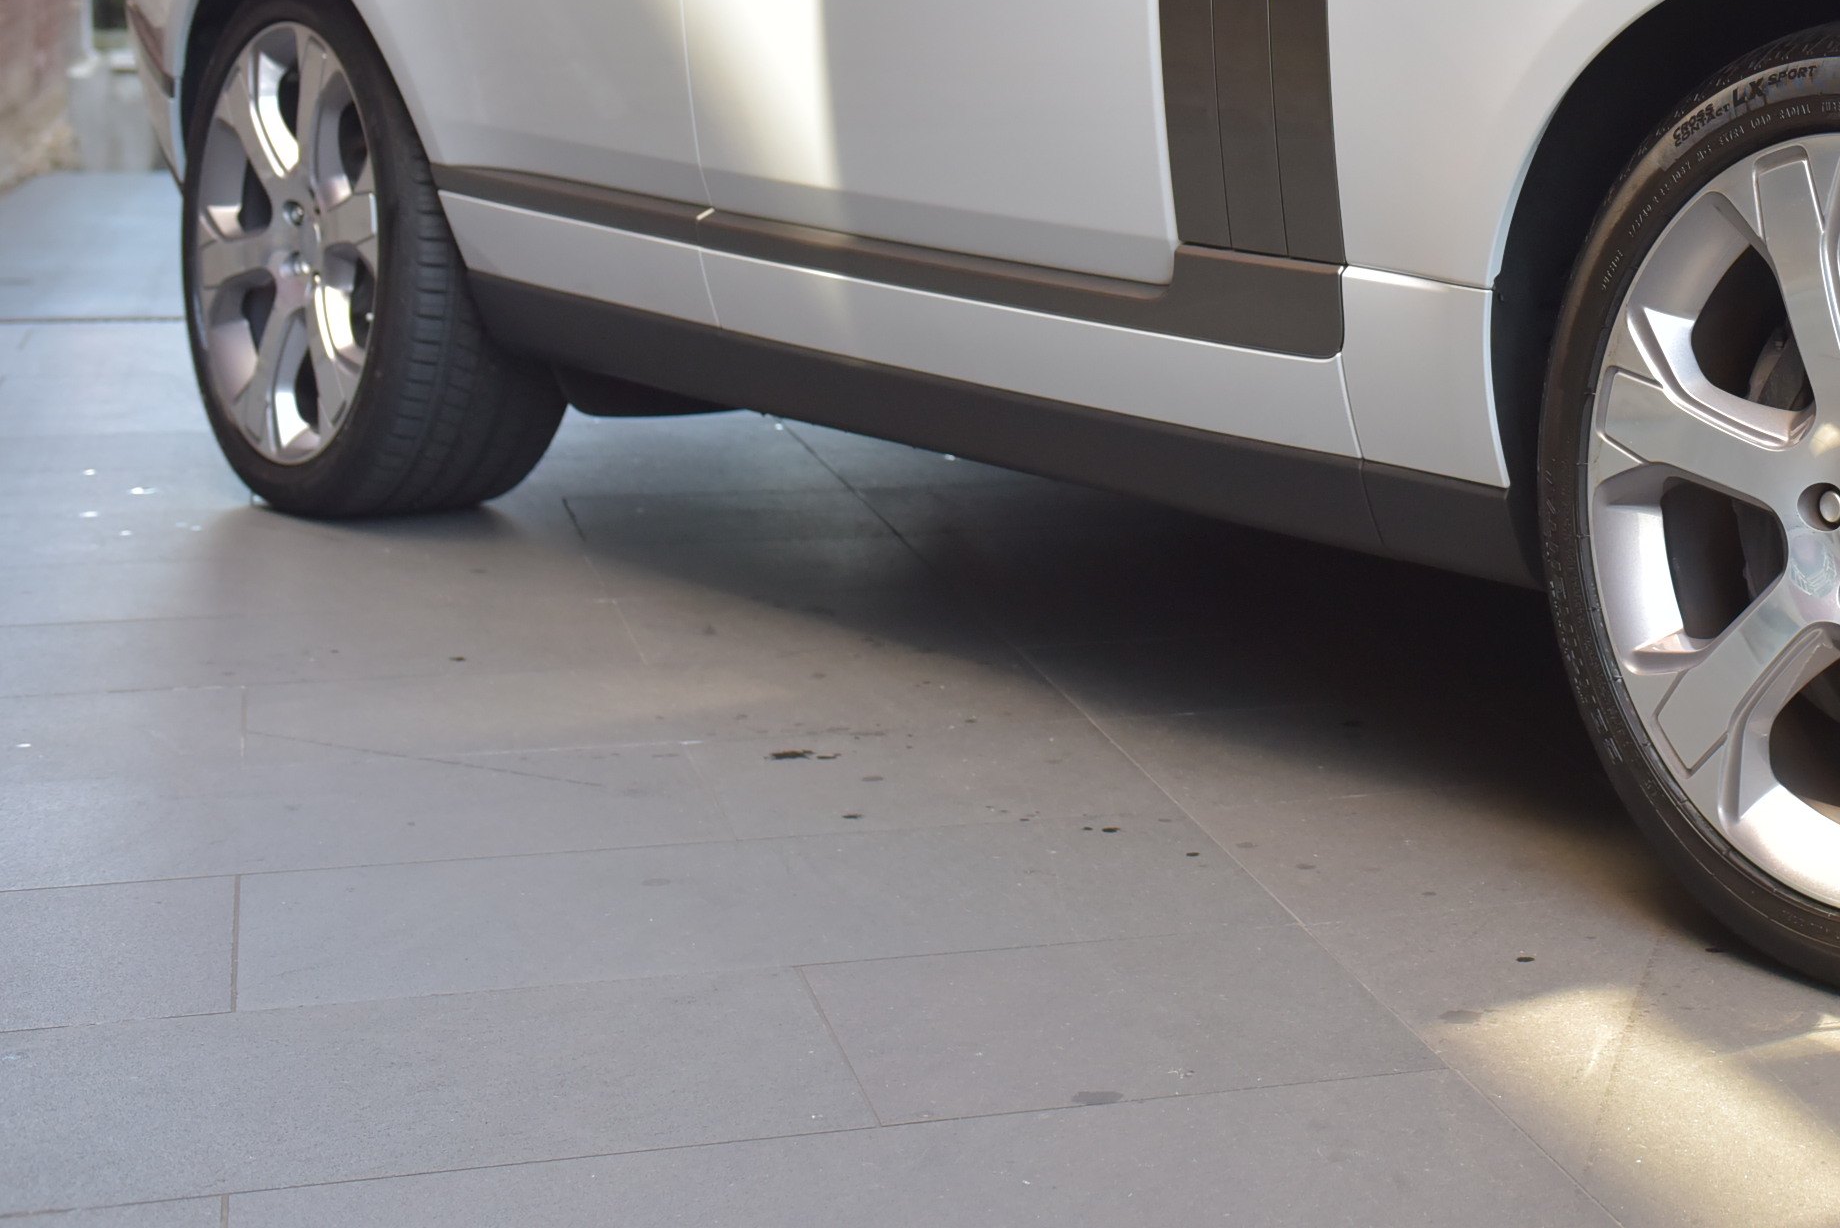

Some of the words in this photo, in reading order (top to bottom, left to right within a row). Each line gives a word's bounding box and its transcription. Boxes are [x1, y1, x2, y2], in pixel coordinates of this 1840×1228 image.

[1732, 77, 1765, 106] LX
[1767, 65, 1818, 87] SPORT
[1672, 103, 1714, 140] CROSS
[1674, 103, 1731, 146] CONTACT
